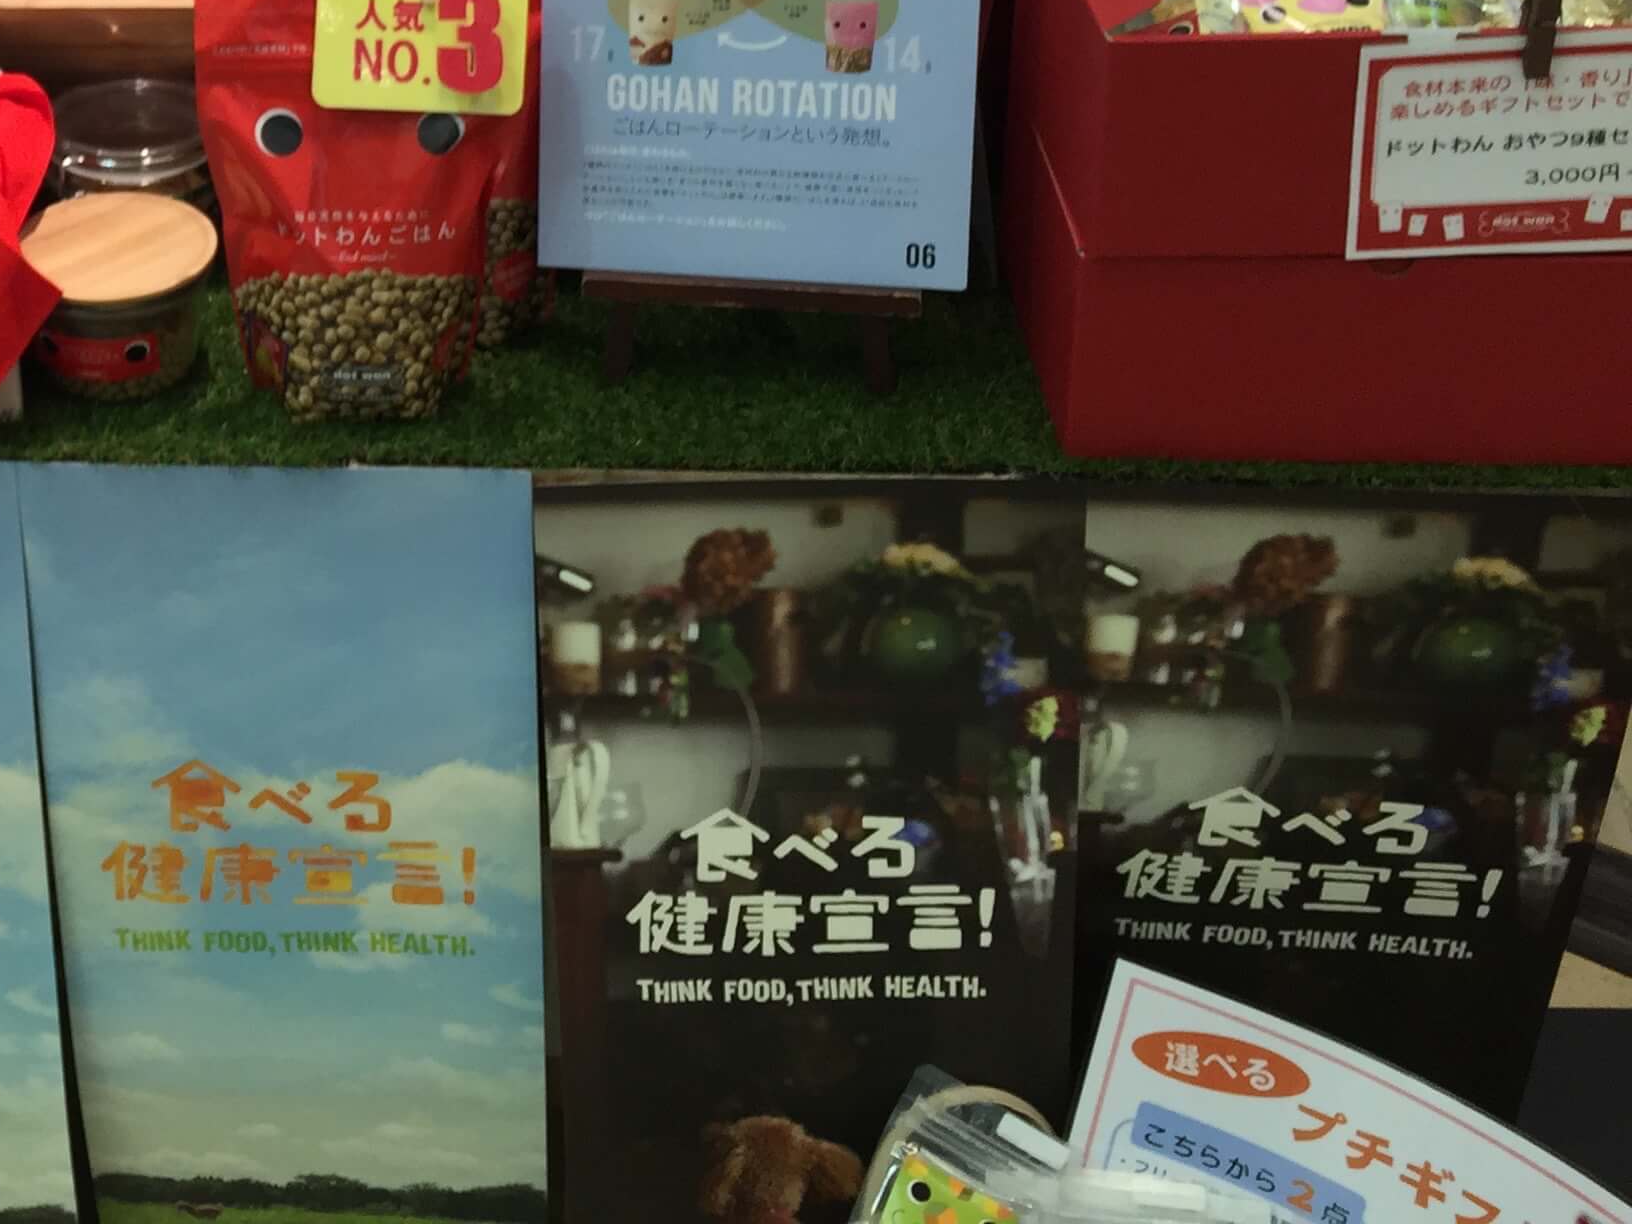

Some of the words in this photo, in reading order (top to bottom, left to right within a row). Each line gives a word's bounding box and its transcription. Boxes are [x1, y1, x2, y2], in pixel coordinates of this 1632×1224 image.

[570, 26, 606, 65] 17
[884, 35, 922, 74] 14
[607, 75, 719, 114] GOHAN
[733, 79, 898, 122] ROTATION
[612, 117, 891, 148] ごはんローテーションという発想。
[1387, 135, 1494, 158] ドットわん
[1525, 161, 1620, 186] 3,000円
[1492, 216, 1519, 227] dot
[1524, 214, 1555, 226] wan
[905, 241, 937, 270] 06
[151, 759, 393, 833] 食べる
[1188, 785, 1430, 856] 食べる
[680, 808, 916, 883] 食べる
[101, 839, 477, 906] 健康宣言！
[1115, 847, 1504, 919] 健康宣言！
[625, 884, 997, 957] 健康宣言！
[1114, 917, 1193, 942] THINK
[1278, 928, 1358, 952] THINK
[1368, 931, 1474, 960] HEALTH.
[115, 927, 192, 953] THINK
[279, 931, 359, 954] THINK
[370, 931, 477, 958] HEALTH.
[636, 977, 713, 1005] THINK
[724, 979, 795, 1007] FOOD,
[796, 975, 874, 1000] THINK
[885, 974, 988, 1000] HEALTH.
[1165, 1040, 1277, 1093] 選べる
